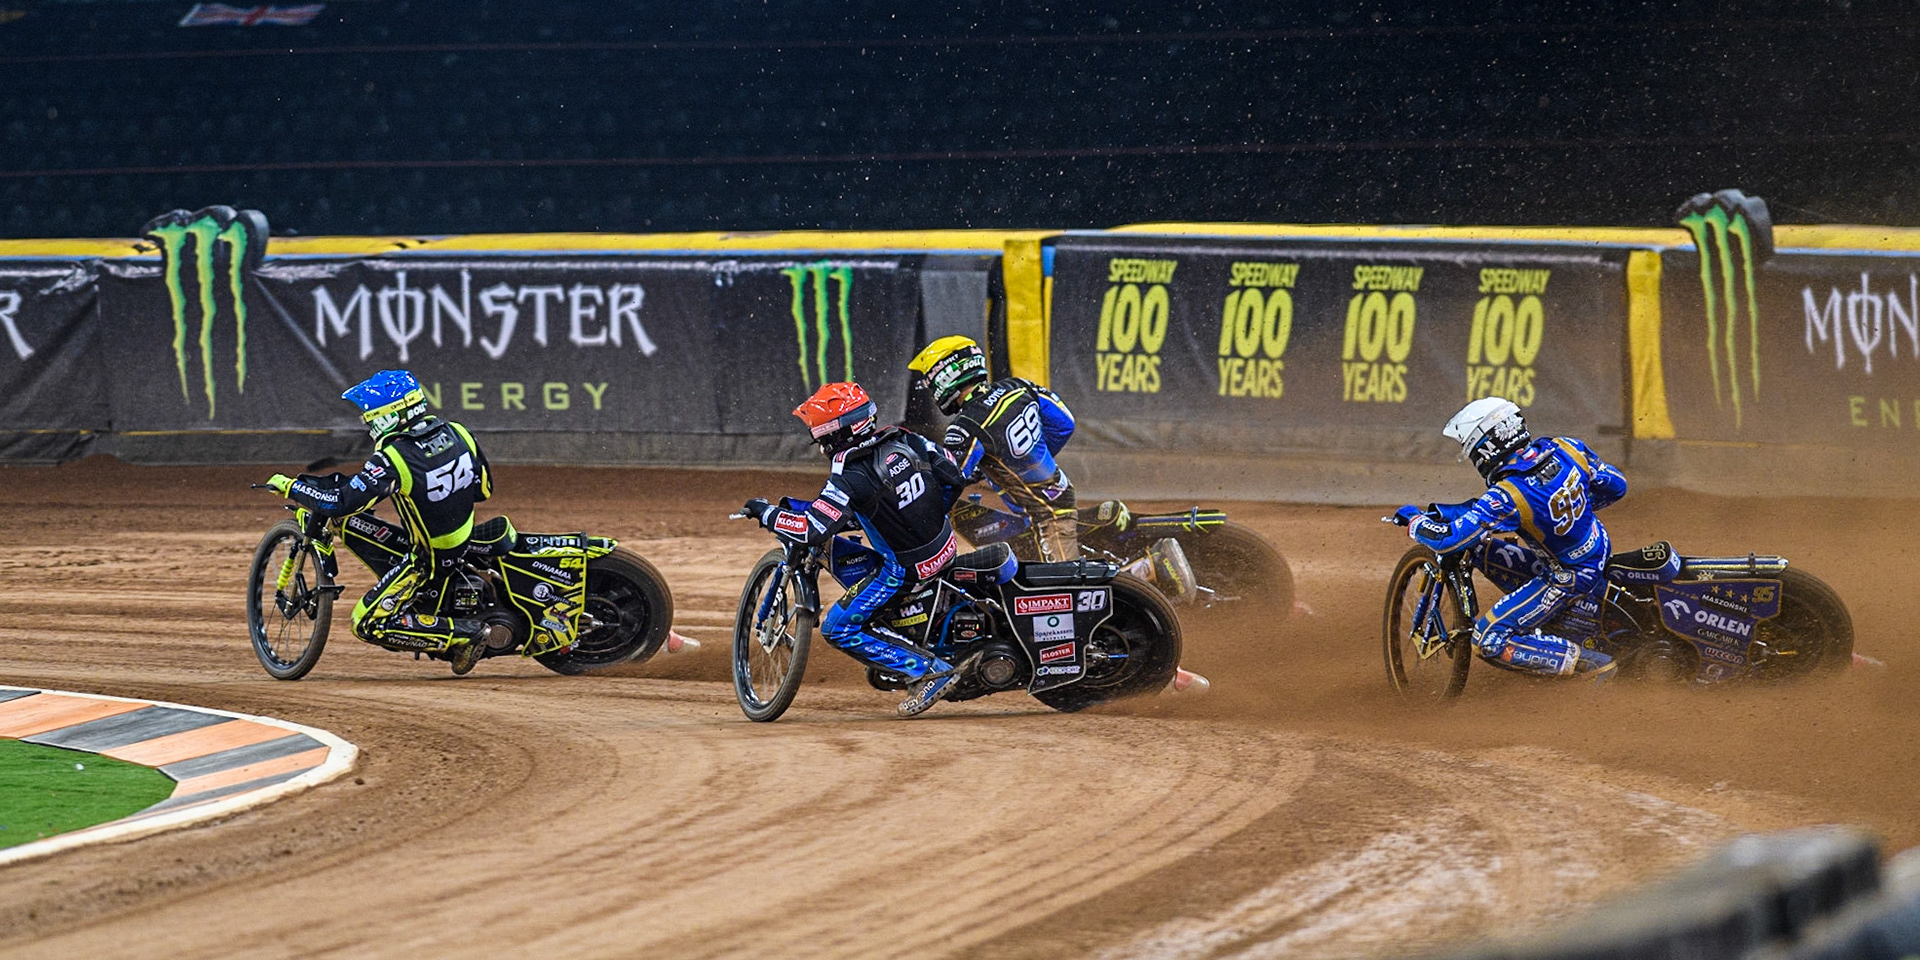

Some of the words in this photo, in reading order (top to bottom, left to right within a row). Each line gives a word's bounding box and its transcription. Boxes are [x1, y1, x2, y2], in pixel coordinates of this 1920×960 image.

[1108, 258, 1178, 284] SPEEDWAY
[1229, 261, 1300, 287] SPEEDWAY
[1353, 265, 1424, 291] SPEEDWAY
[1478, 268, 1551, 294] SPEEDWAY
[311, 268, 657, 362] MONSTER
[1096, 283, 1170, 354] 100
[1218, 287, 1294, 359] 100
[1341, 290, 1416, 363] 100
[1466, 294, 1545, 367] 100
[1096, 353, 1162, 393] YEARS
[1218, 358, 1284, 398] YEARS
[1342, 362, 1408, 403] YEARS
[417, 382, 608, 411] NERGY
[983, 387, 1006, 407] DOYLE
[1466, 366, 1537, 407] YEARS
[1006, 401, 1042, 459] 69
[425, 451, 474, 502] 54
[889, 458, 911, 477] ADSE
[895, 472, 926, 510] 30
[1547, 466, 1587, 535] 95
[559, 557, 582, 569] 54
[846, 555, 868, 565] NORDIC
[929, 539, 956, 569] IMPAKT
[532, 561, 572, 580] DYNAMAX
[1627, 572, 1660, 581] ORLEN
[1028, 598, 1069, 608] IMPAKT
[1077, 590, 1106, 612] 30
[1701, 594, 1748, 613] MASZOŃSKI
[1752, 586, 1776, 604] 95
[1035, 629, 1074, 639] Sparekassen
[1694, 610, 1751, 637] ORLEN
[1042, 647, 1071, 659] KLOSTER
[1502, 646, 1559, 670] budnex
[902, 680, 936, 709] daytona
